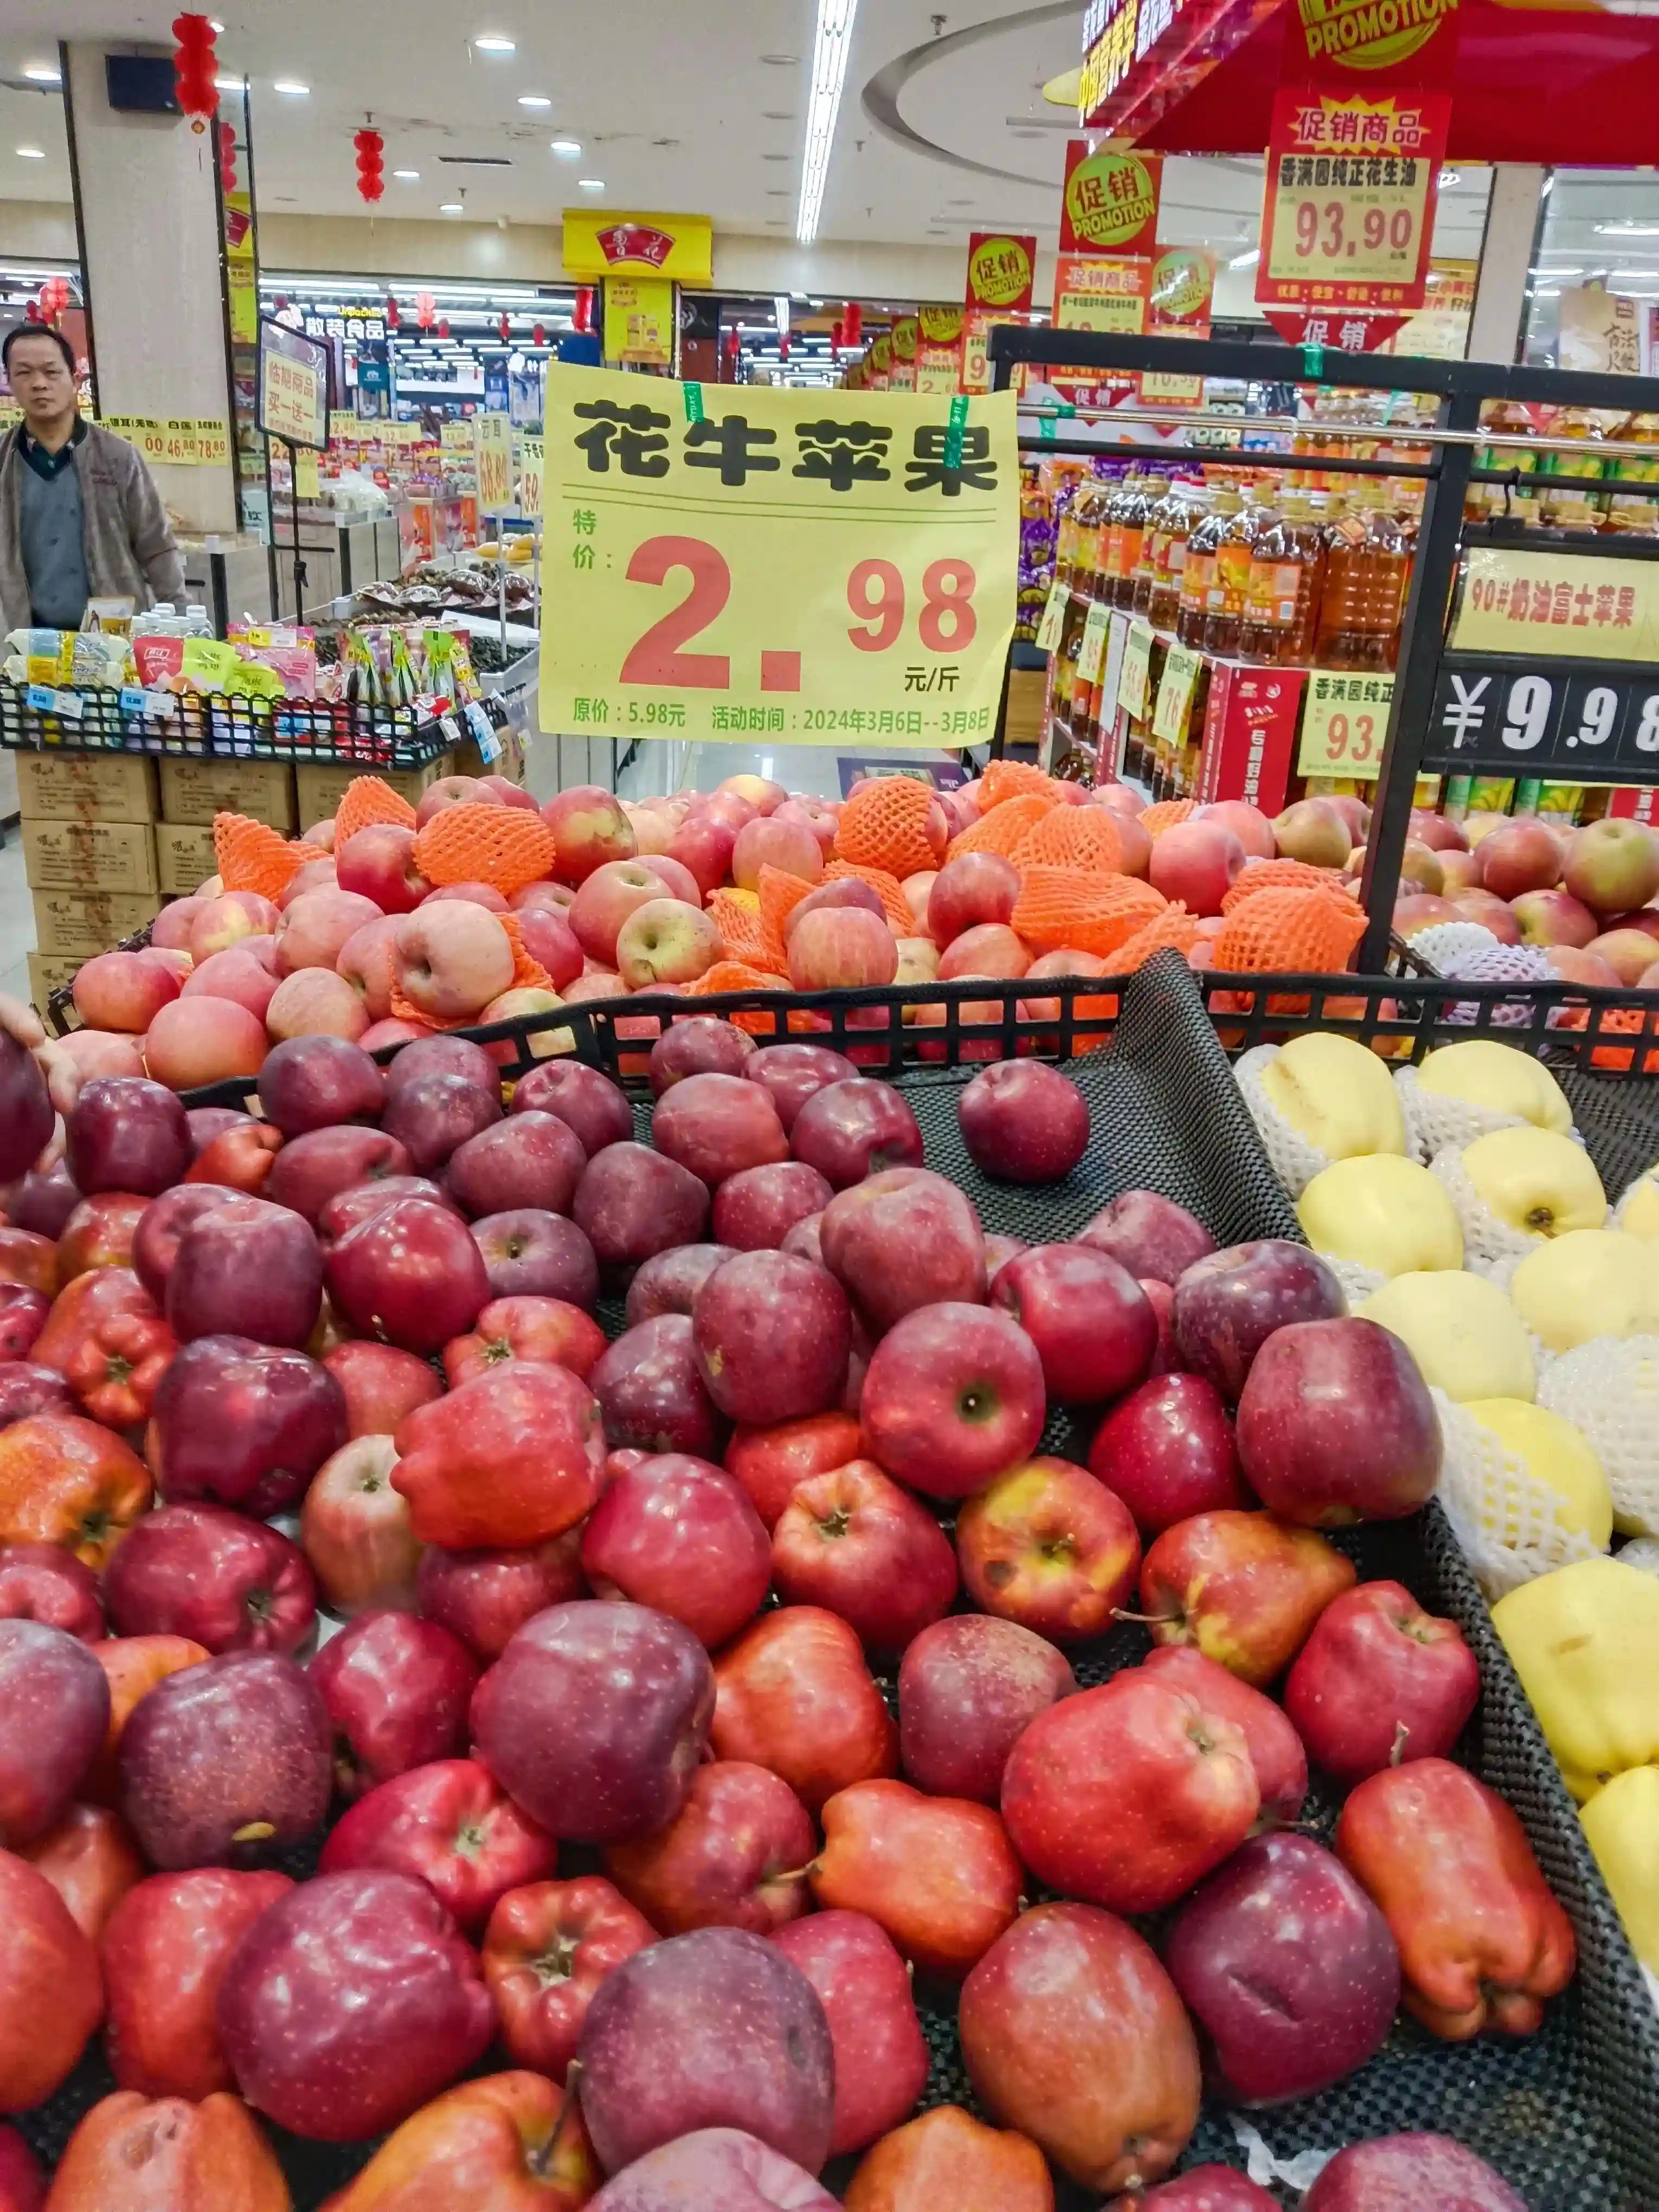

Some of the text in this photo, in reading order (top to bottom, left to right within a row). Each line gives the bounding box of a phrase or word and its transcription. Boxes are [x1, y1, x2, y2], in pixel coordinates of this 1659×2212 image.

[1306, 0, 1459, 60] PROMOTIO
[1300, 110, 1420, 145] 促销商品
[1076, 166, 1140, 215] 促销
[1072, 198, 1156, 240] PROMOTION
[1295, 201, 1413, 258] 93.90
[1302, 319, 1366, 350] 促销
[268, 391, 313, 423] 买一送一
[573, 398, 998, 497] 花牛苹果
[619, 535, 977, 692] 2.98
[1471, 577, 1635, 629] 90#奶油富士苹果
[904, 667, 960, 693] 元/斤
